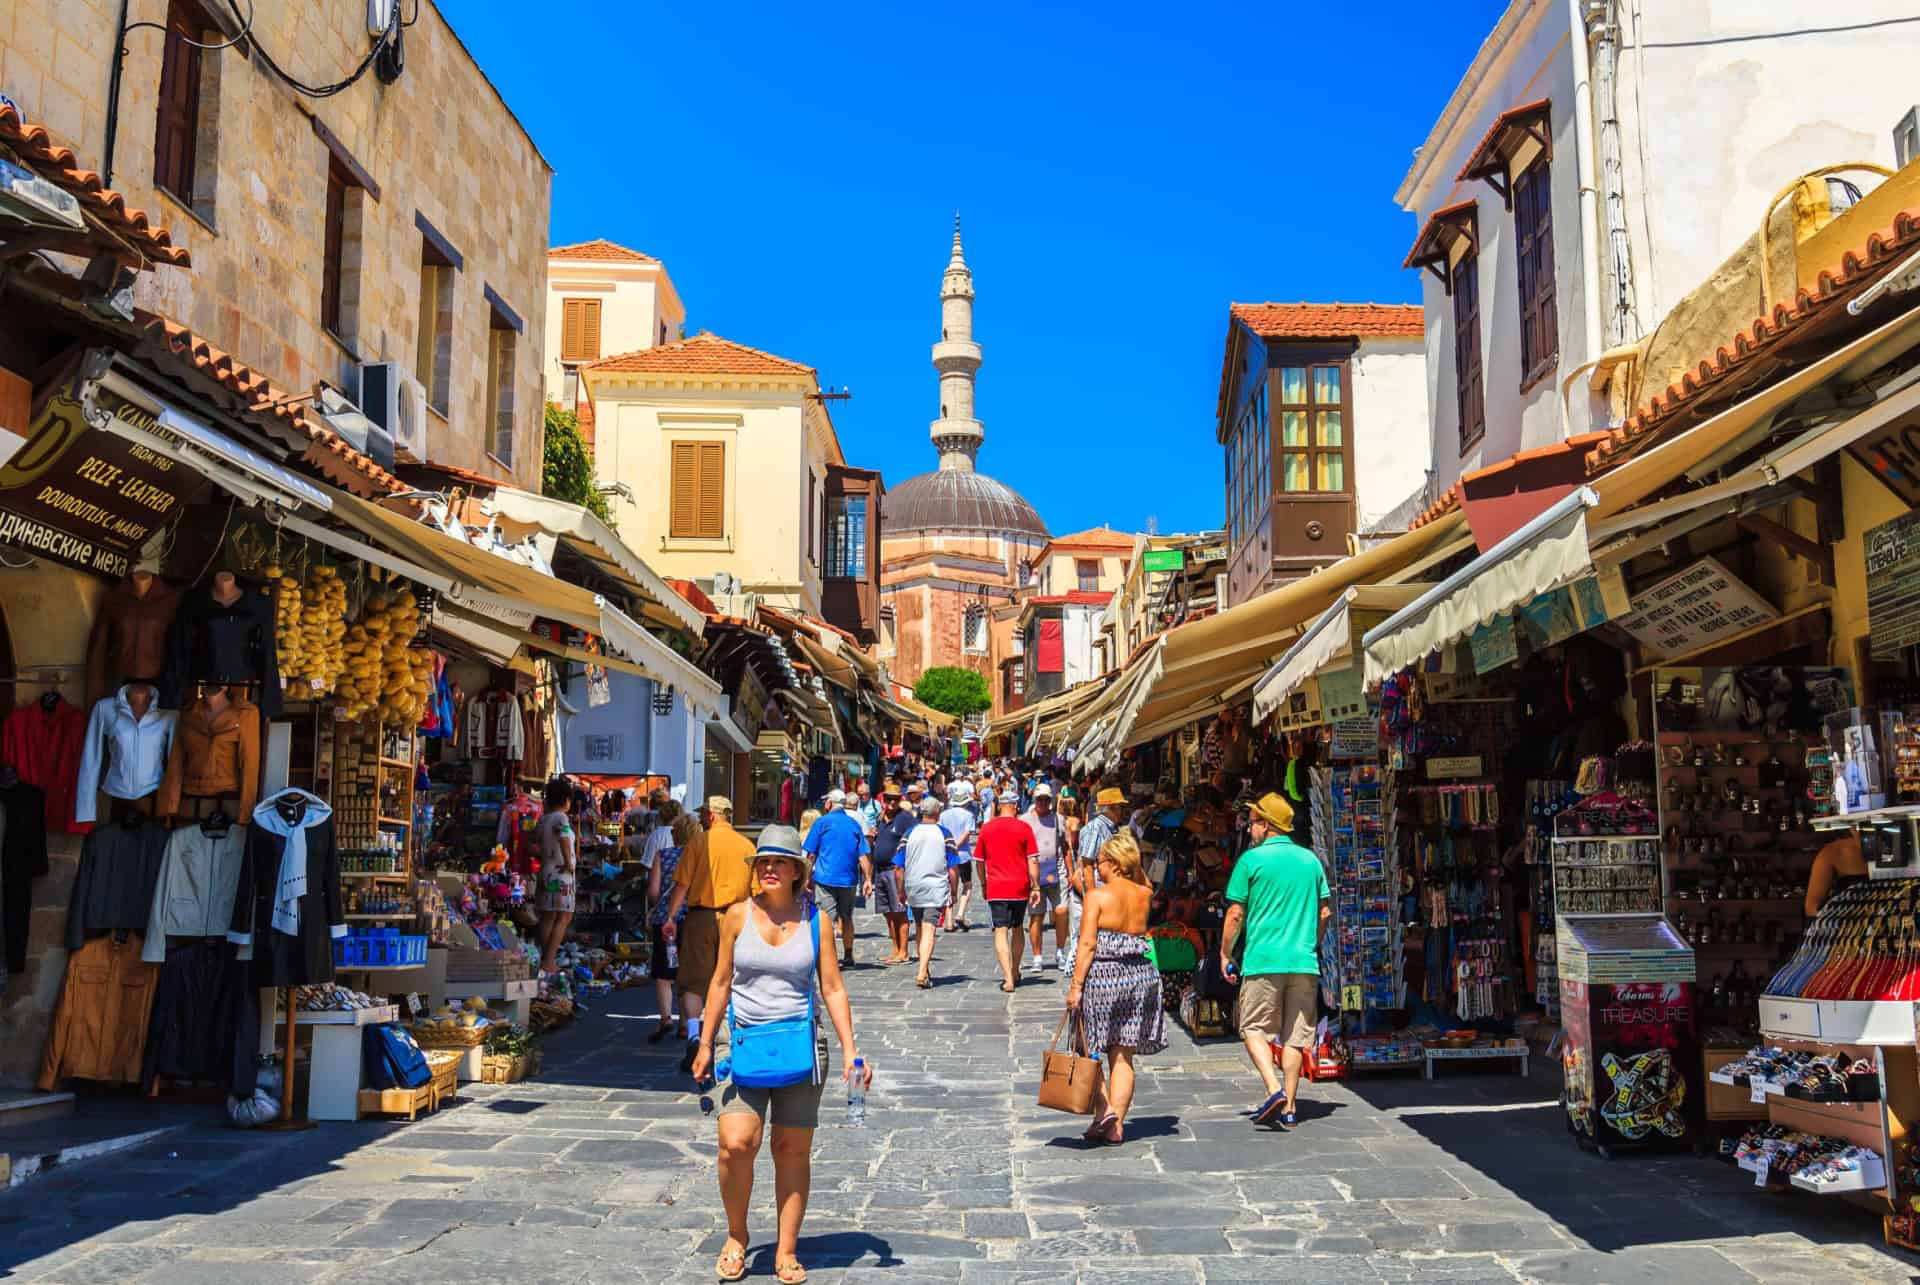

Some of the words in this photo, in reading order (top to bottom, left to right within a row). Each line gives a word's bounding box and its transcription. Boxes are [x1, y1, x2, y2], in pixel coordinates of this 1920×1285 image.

[76, 456, 123, 487] PELZE
[119, 476, 176, 513] LEATHER
[92, 548, 129, 577] меха
[1617, 987, 1656, 1001] Charms
[1599, 1006, 1689, 1025] TREASURE
